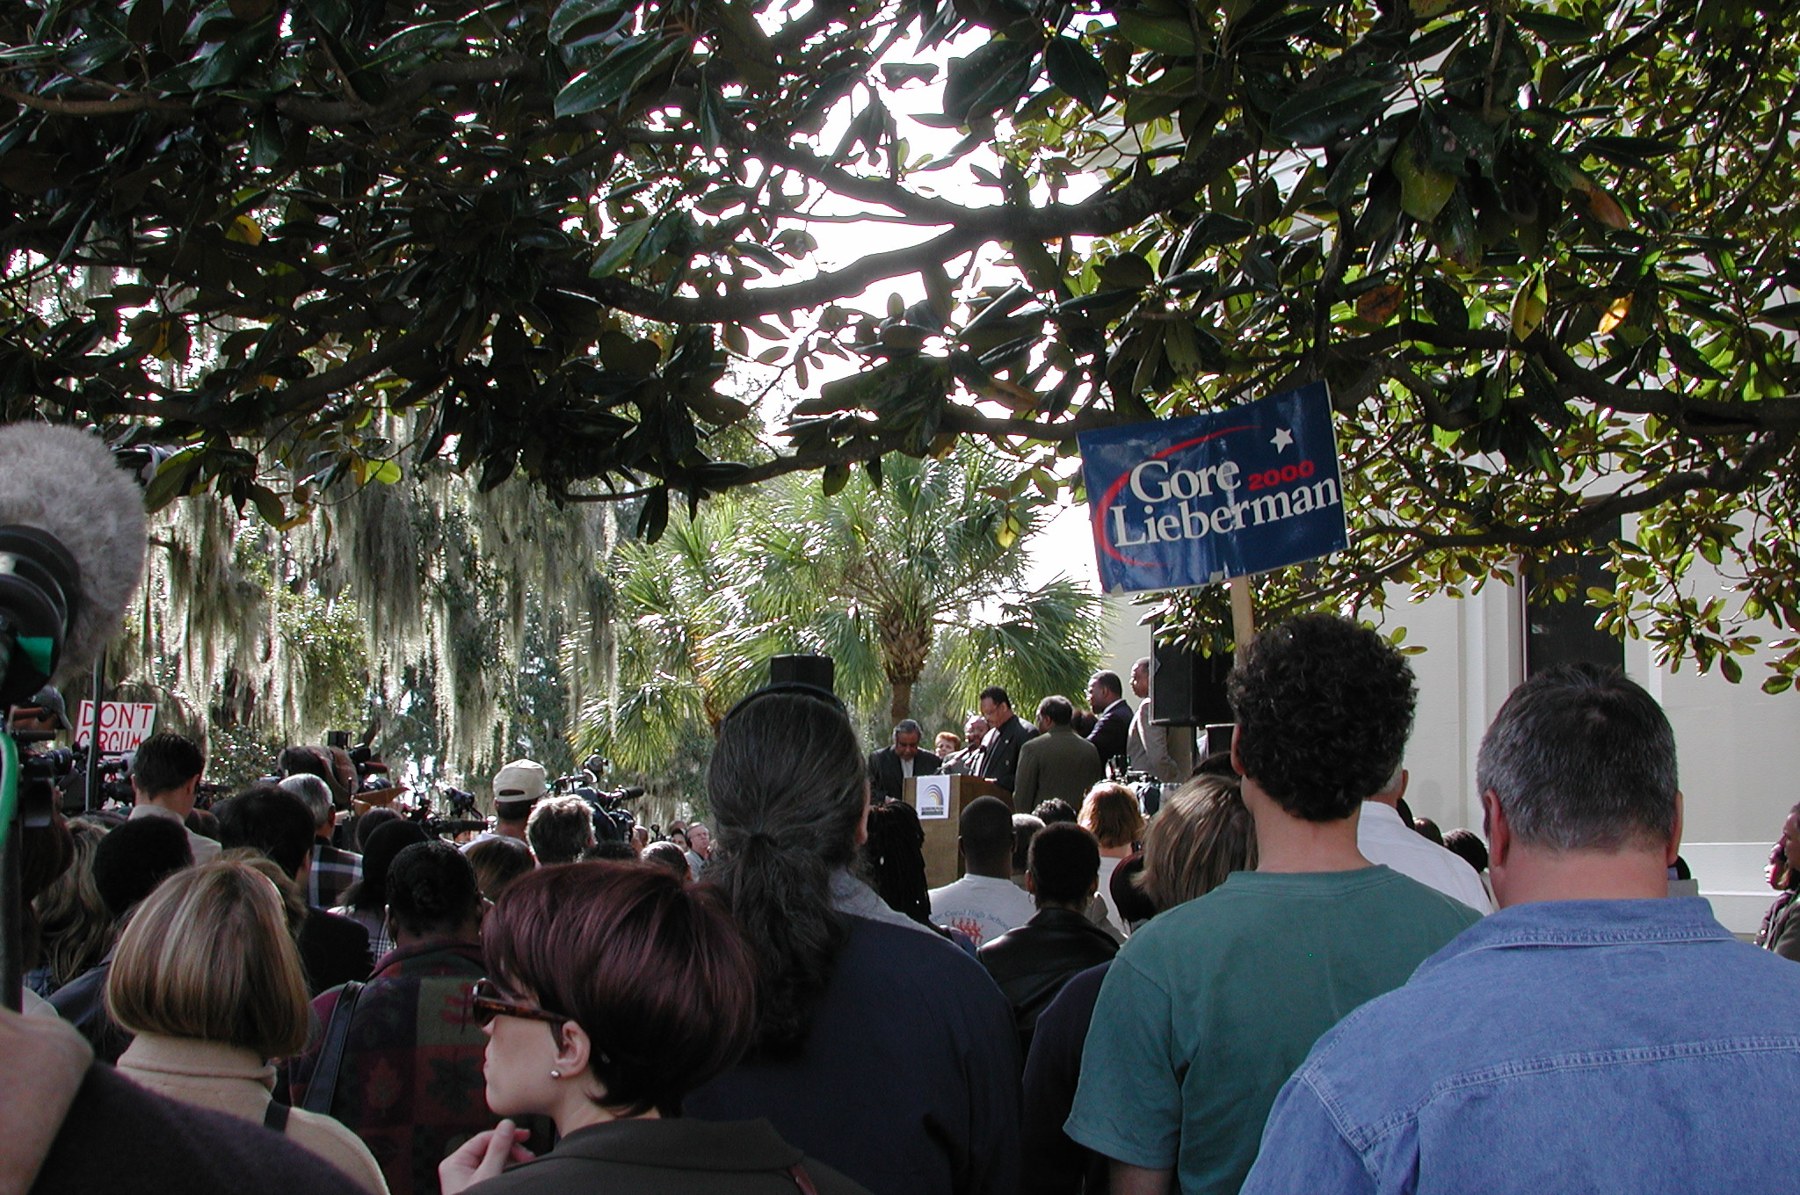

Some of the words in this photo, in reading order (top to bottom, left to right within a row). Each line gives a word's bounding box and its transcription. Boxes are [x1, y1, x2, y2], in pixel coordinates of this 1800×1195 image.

[1129, 459, 1241, 503] Gore
[1248, 460, 1315, 491] 2000
[1110, 477, 1340, 548] Lieberman
[82, 702, 153, 729] DON'T
[78, 730, 142, 751] CRCUM
